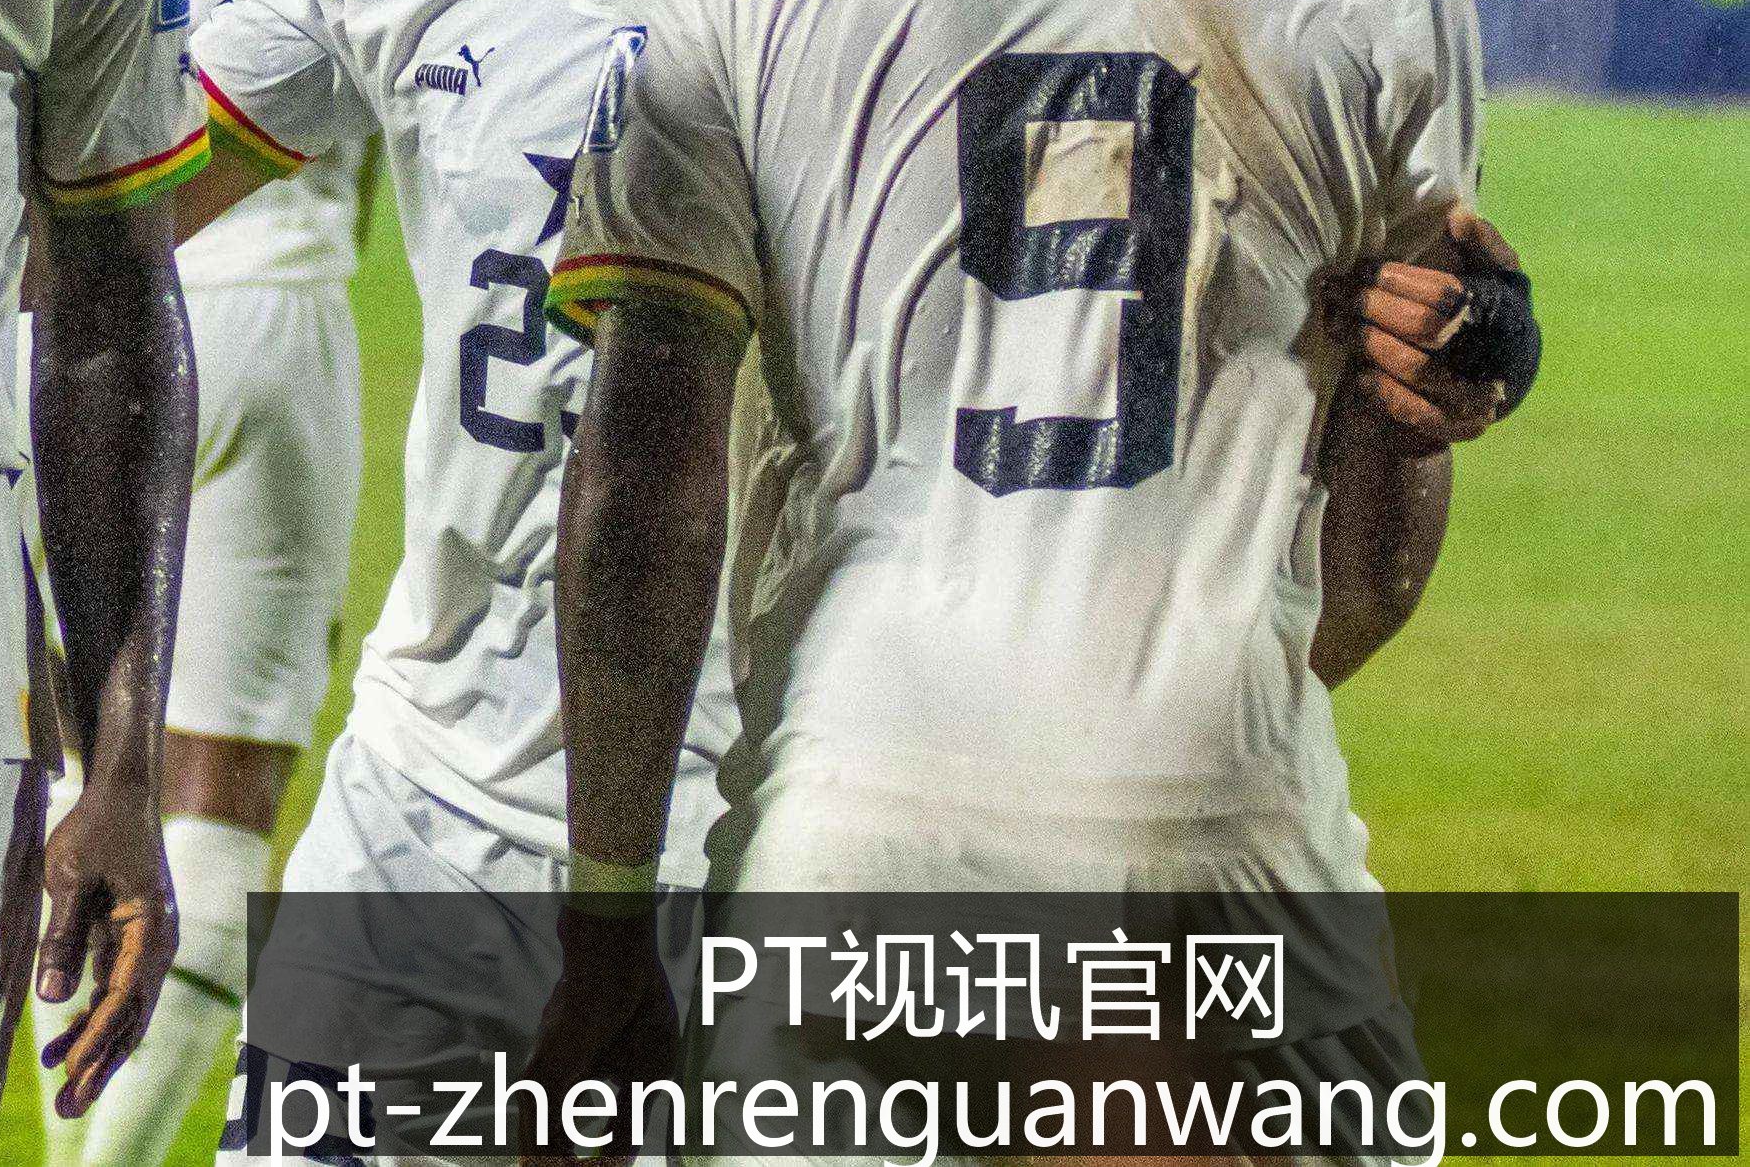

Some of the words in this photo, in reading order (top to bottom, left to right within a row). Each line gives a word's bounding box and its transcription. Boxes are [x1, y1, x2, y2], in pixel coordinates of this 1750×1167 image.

[414, 63, 469, 96] PUMA
[459, 247, 583, 453] 2
[952, 52, 1198, 498] 9
